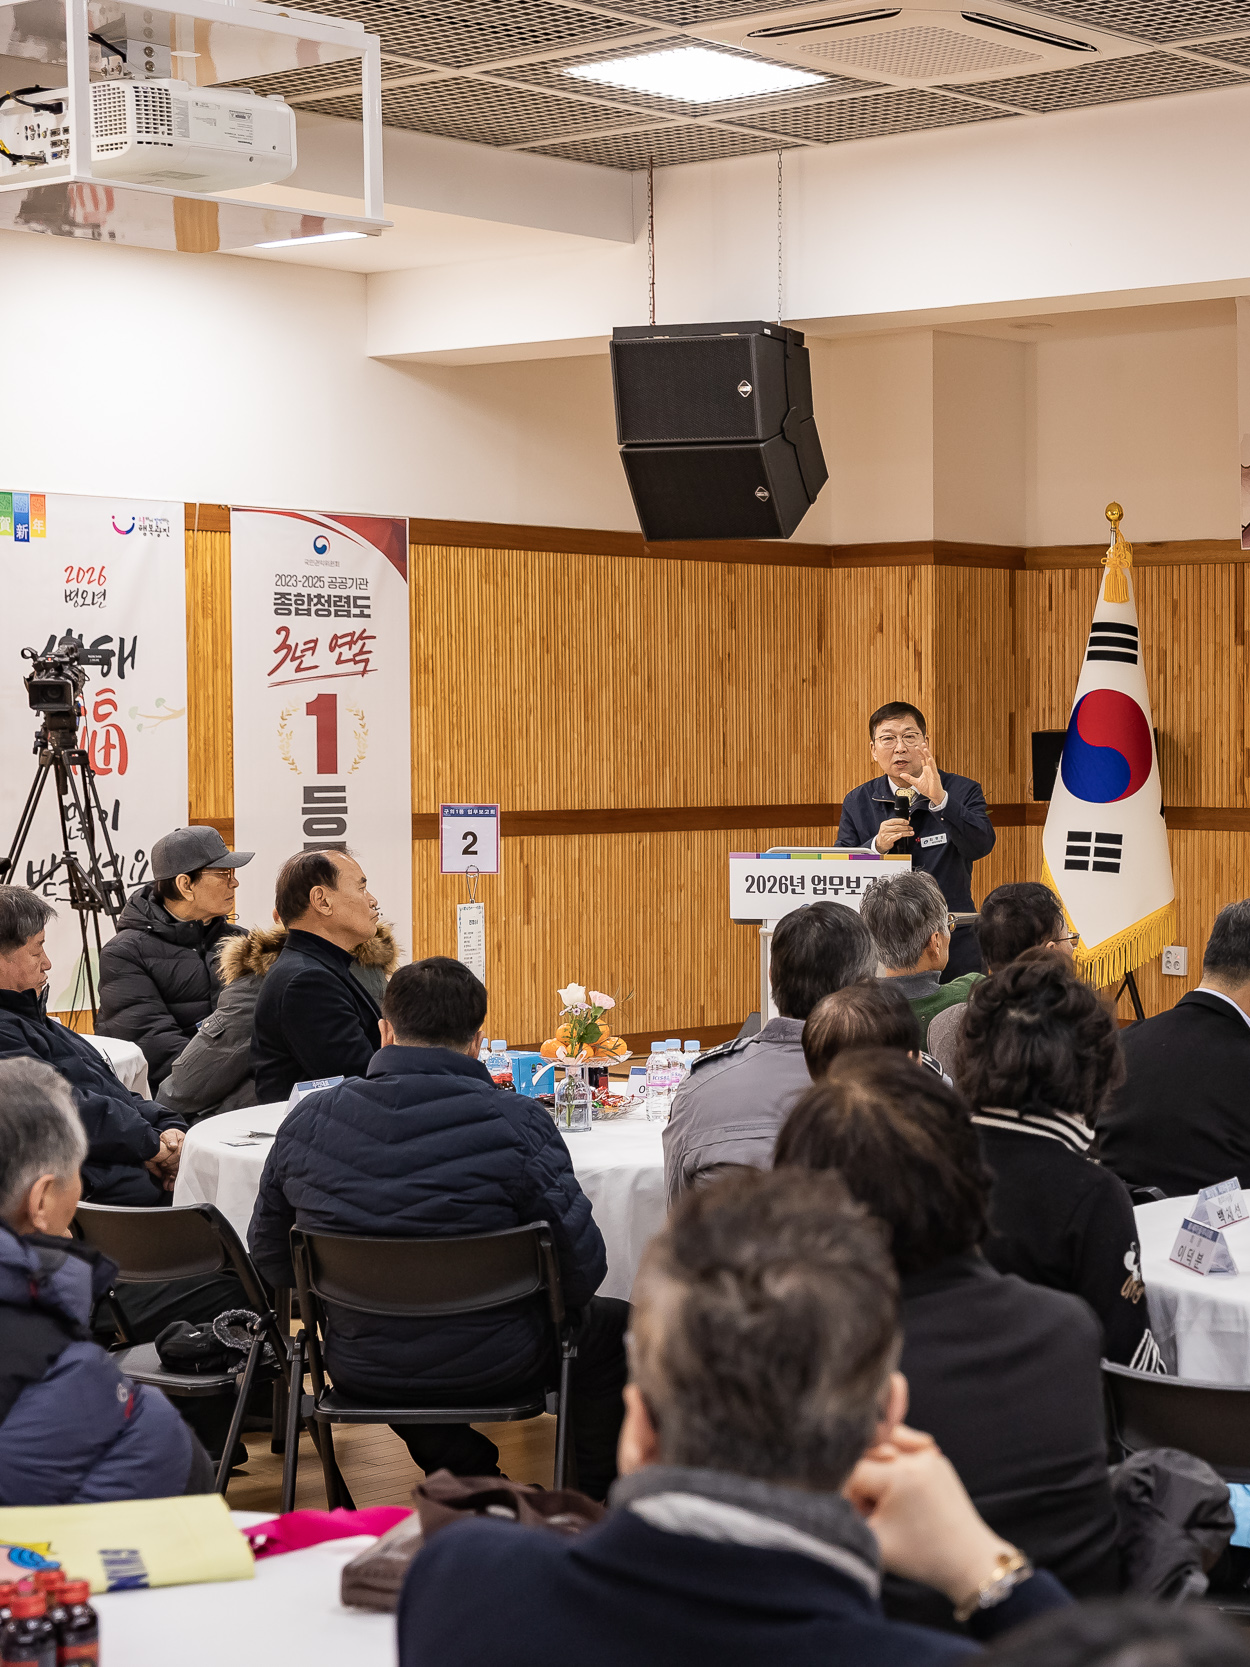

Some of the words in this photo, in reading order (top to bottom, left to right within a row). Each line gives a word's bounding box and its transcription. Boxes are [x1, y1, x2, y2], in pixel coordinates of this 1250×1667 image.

[64, 565, 107, 587] 2026
[275, 573, 325, 589] 2023-2025
[327, 576, 369, 590] 공공기관
[64, 588, 107, 609] 병오년
[273, 591, 372, 619] 종합청렴도
[267, 625, 320, 676] 3년
[328, 628, 377, 677] 연속
[304, 693, 338, 775] 1
[461, 831, 478, 855] 2
[745, 874, 805, 895] 2026년
